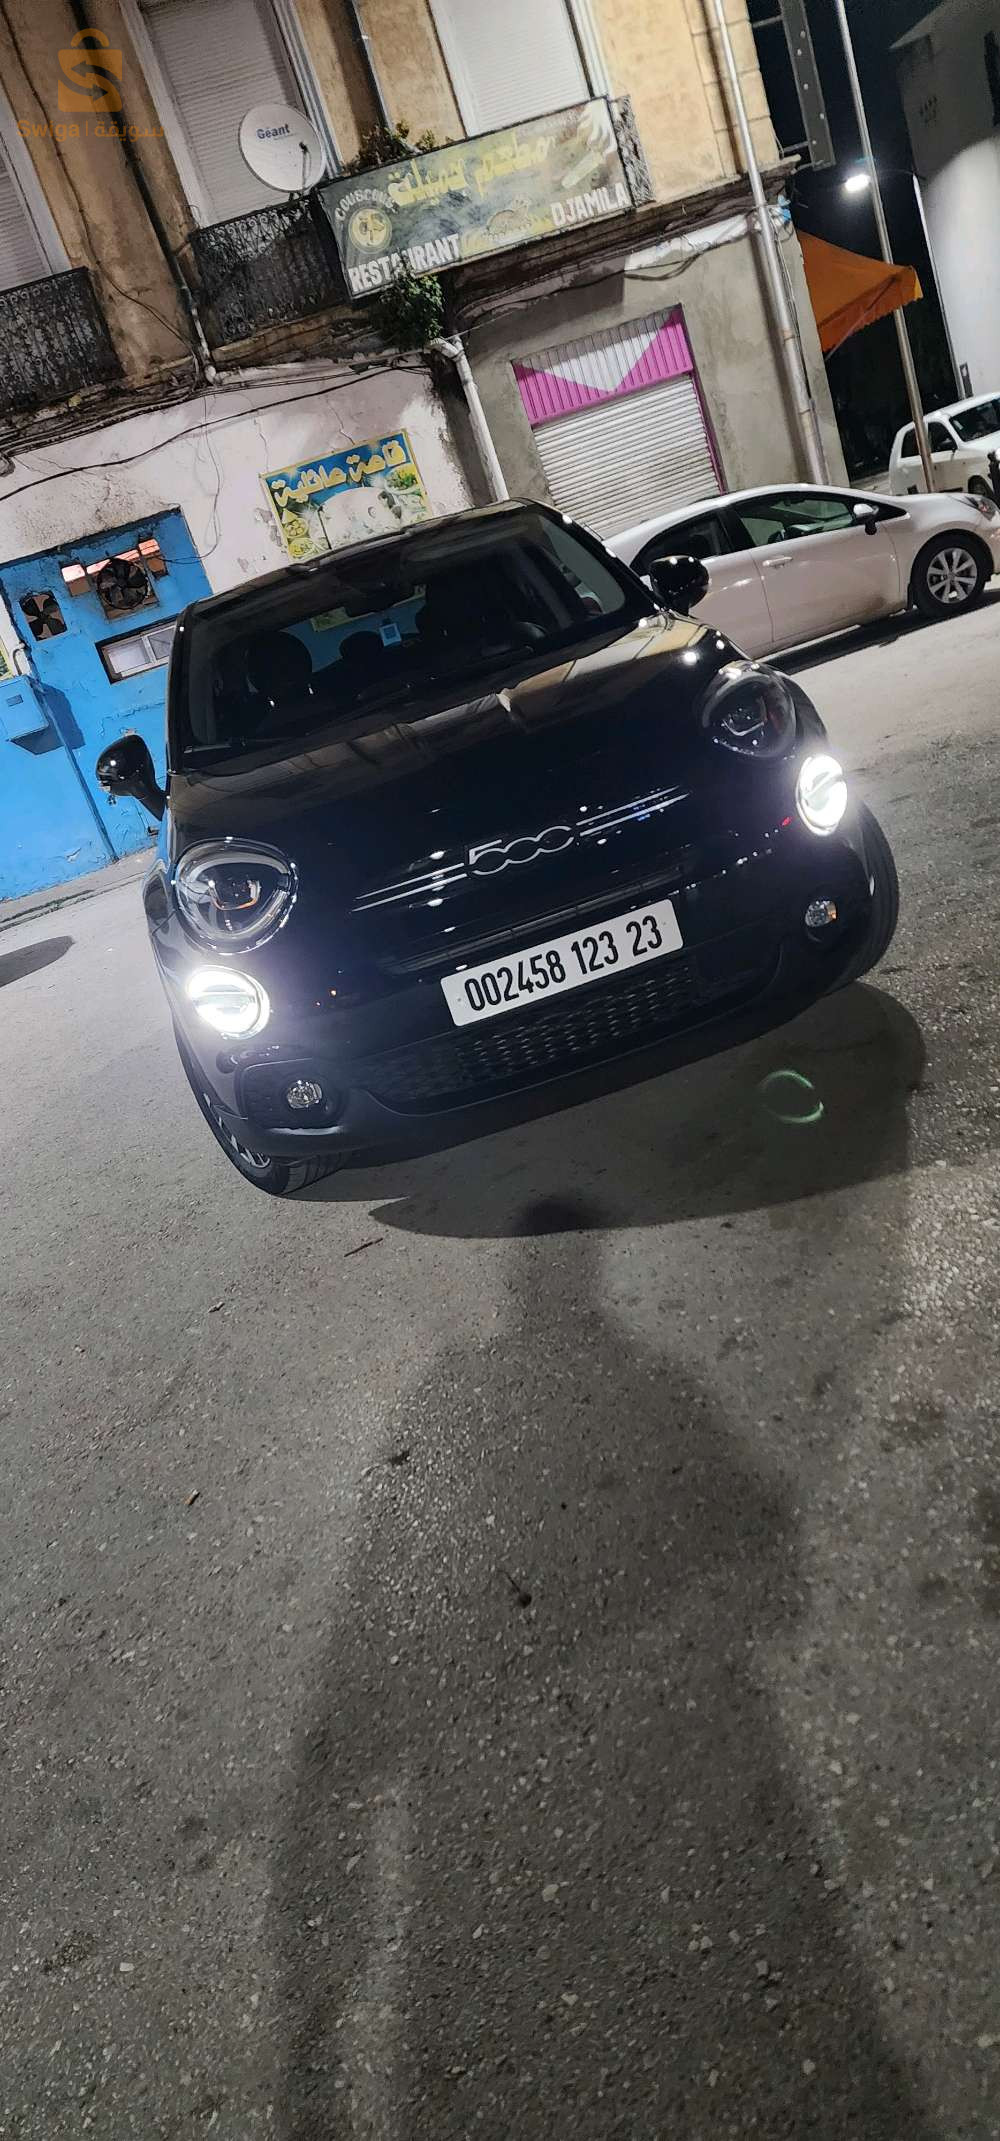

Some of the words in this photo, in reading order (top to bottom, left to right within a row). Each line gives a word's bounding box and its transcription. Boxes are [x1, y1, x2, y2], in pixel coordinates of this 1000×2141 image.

[474, 131, 554, 200] مطعم
[550, 182, 632, 226] DJAMILA
[345, 440, 406, 482] قاعة
[469, 826, 574, 875] 500
[464, 950, 566, 1011] 002458
[571, 930, 619, 975] 123
[626, 915, 663, 957] 23
